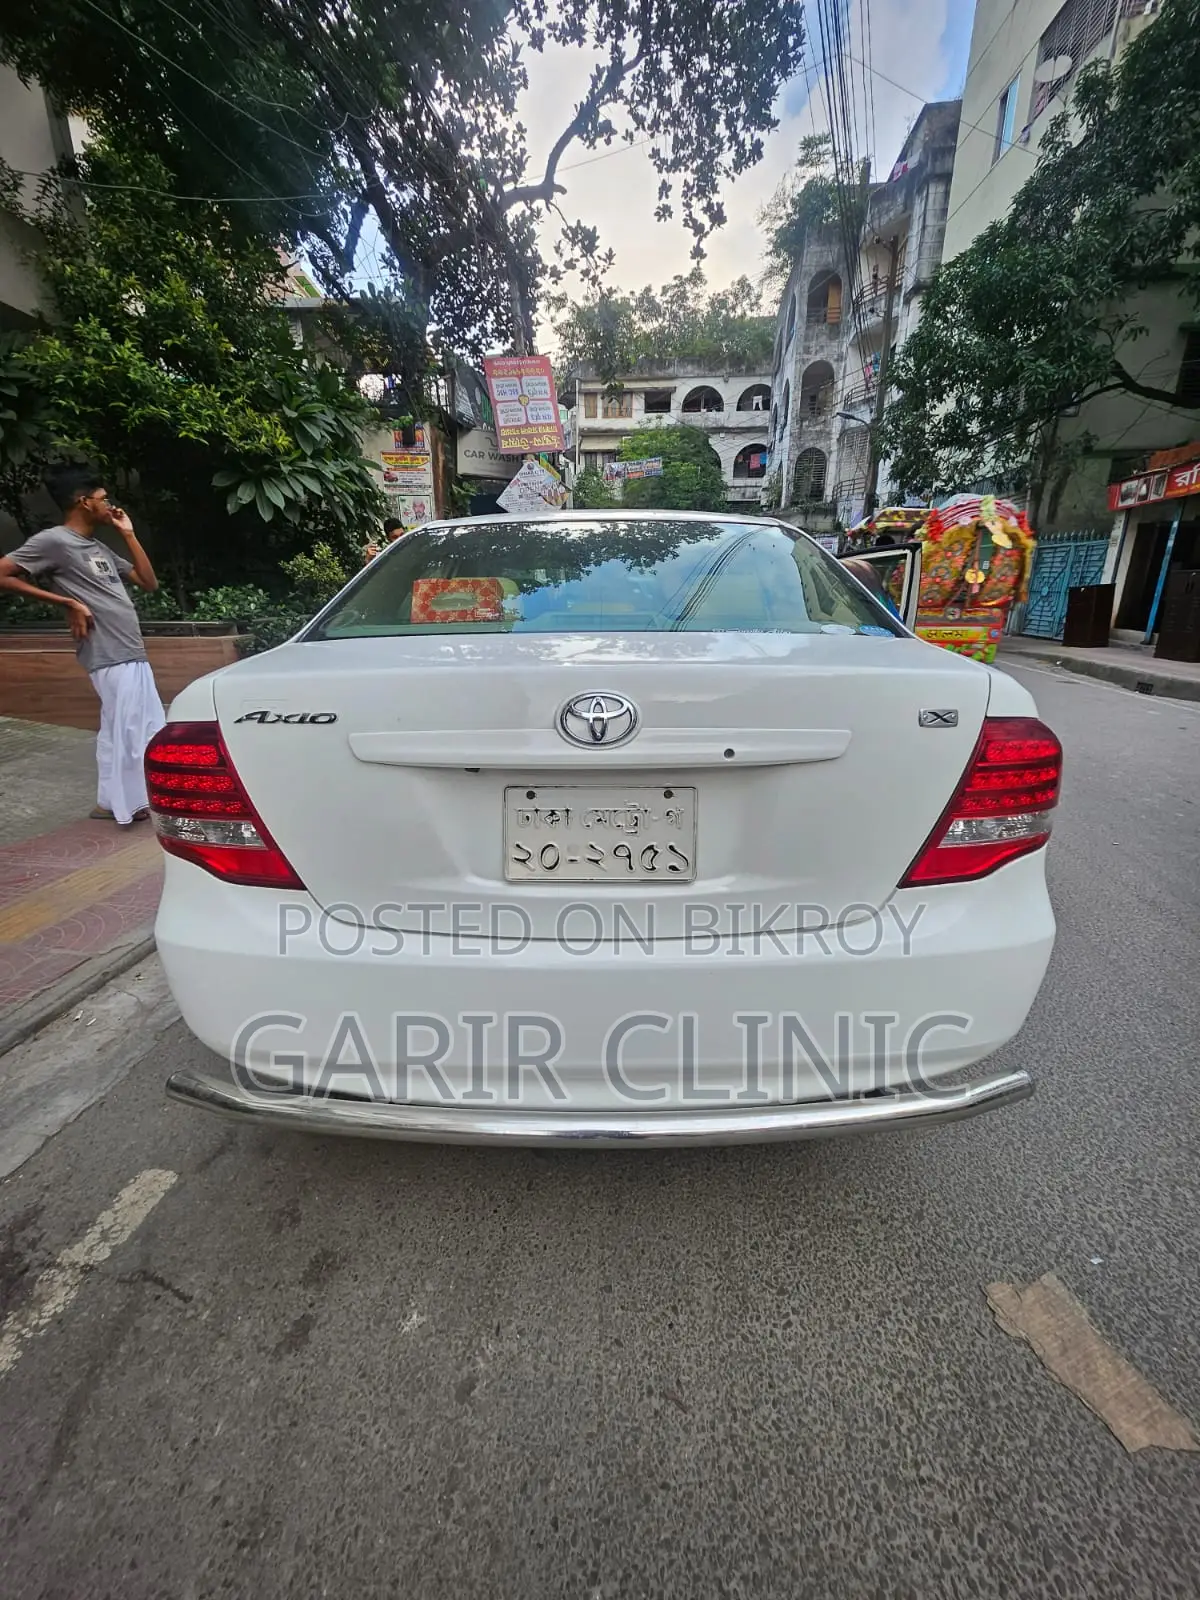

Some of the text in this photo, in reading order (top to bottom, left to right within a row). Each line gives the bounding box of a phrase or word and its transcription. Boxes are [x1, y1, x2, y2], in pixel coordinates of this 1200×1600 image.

[463, 449, 519, 463] CAR WASH
[515, 805, 572, 829] ঢাকা
[512, 842, 690, 873] ২০-২৭৫১
